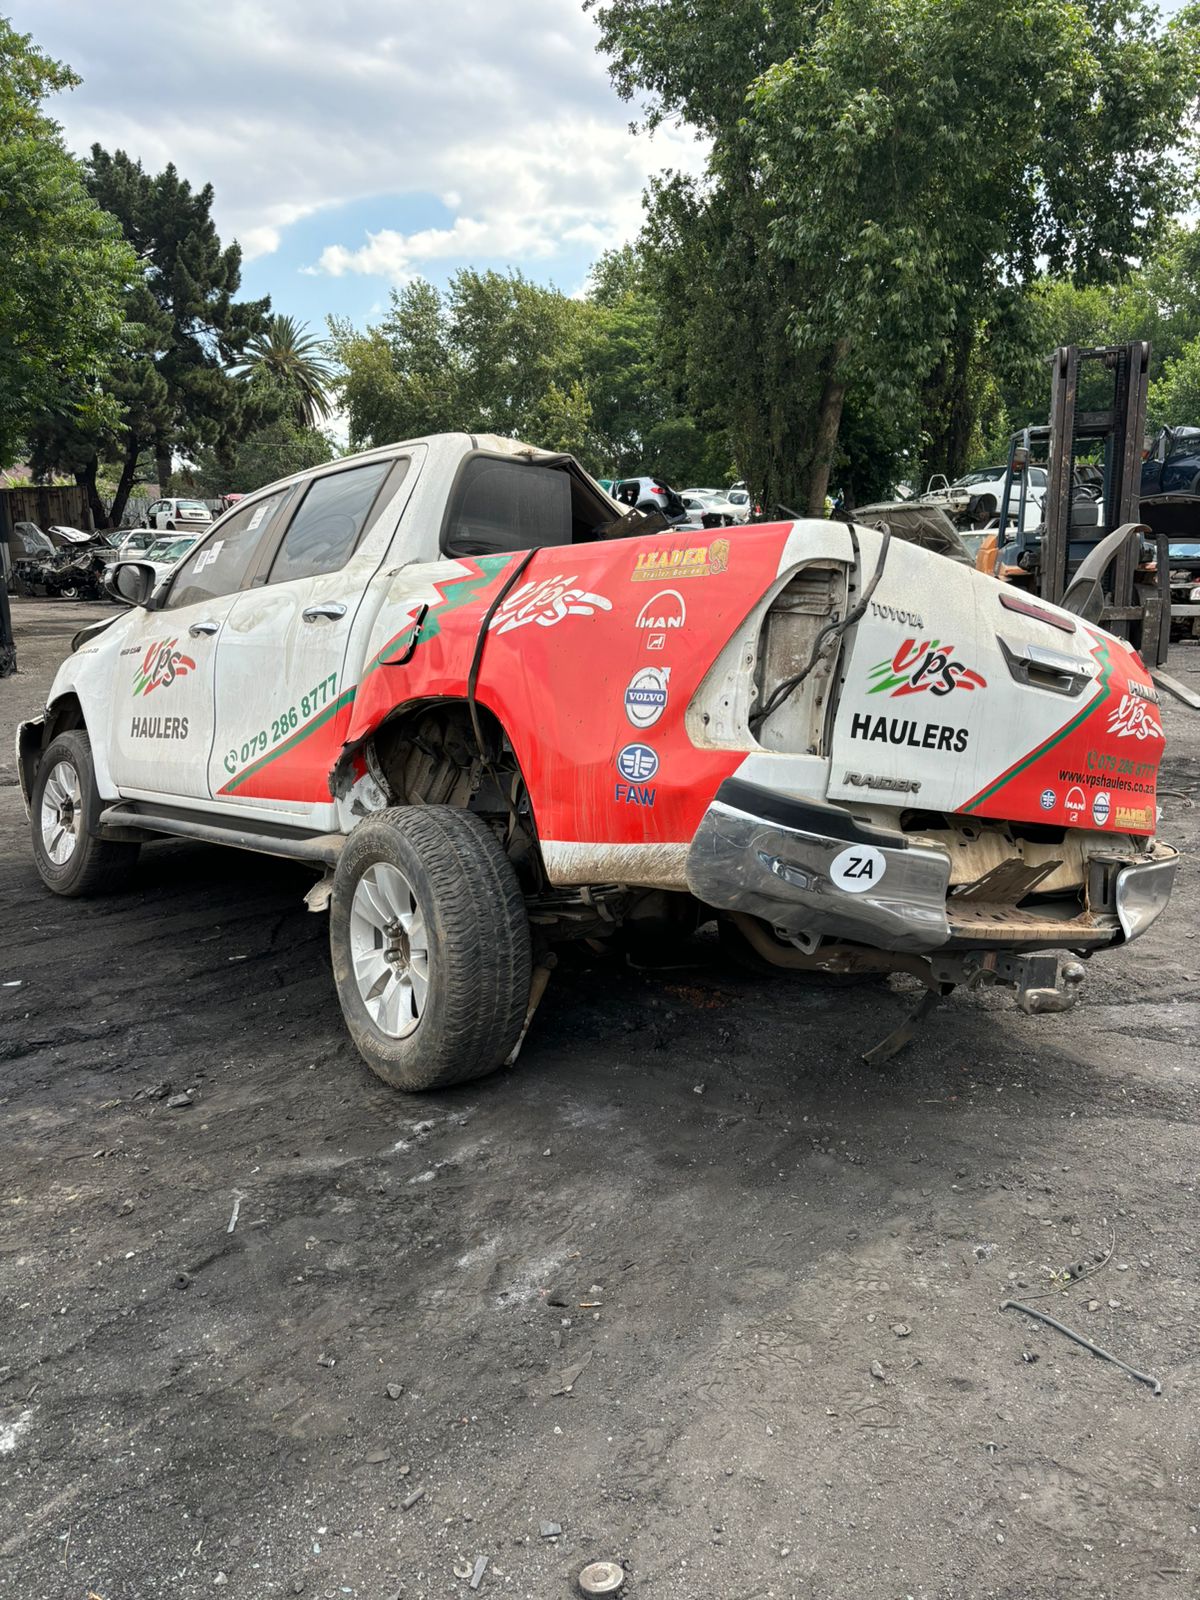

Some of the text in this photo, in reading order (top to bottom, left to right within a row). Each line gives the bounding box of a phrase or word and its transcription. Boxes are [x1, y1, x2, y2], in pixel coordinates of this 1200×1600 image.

[634, 547, 708, 569] LEADER
[640, 616, 681, 628] MAN
[870, 600, 924, 629] TOYOTA
[628, 691, 665, 703] VOLVO
[130, 716, 189, 740] HAULERS
[241, 671, 337, 763] 079 286 8777
[850, 712, 969, 753] HAULERS
[1097, 752, 1117, 771] 079
[1117, 757, 1135, 775] 286
[842, 770, 922, 794] RAIDER
[1059, 769, 1155, 795] www.vpshaulers.co.za
[615, 784, 656, 807] FAW
[1066, 801, 1084, 811] MAN
[843, 857, 874, 879] ZA
